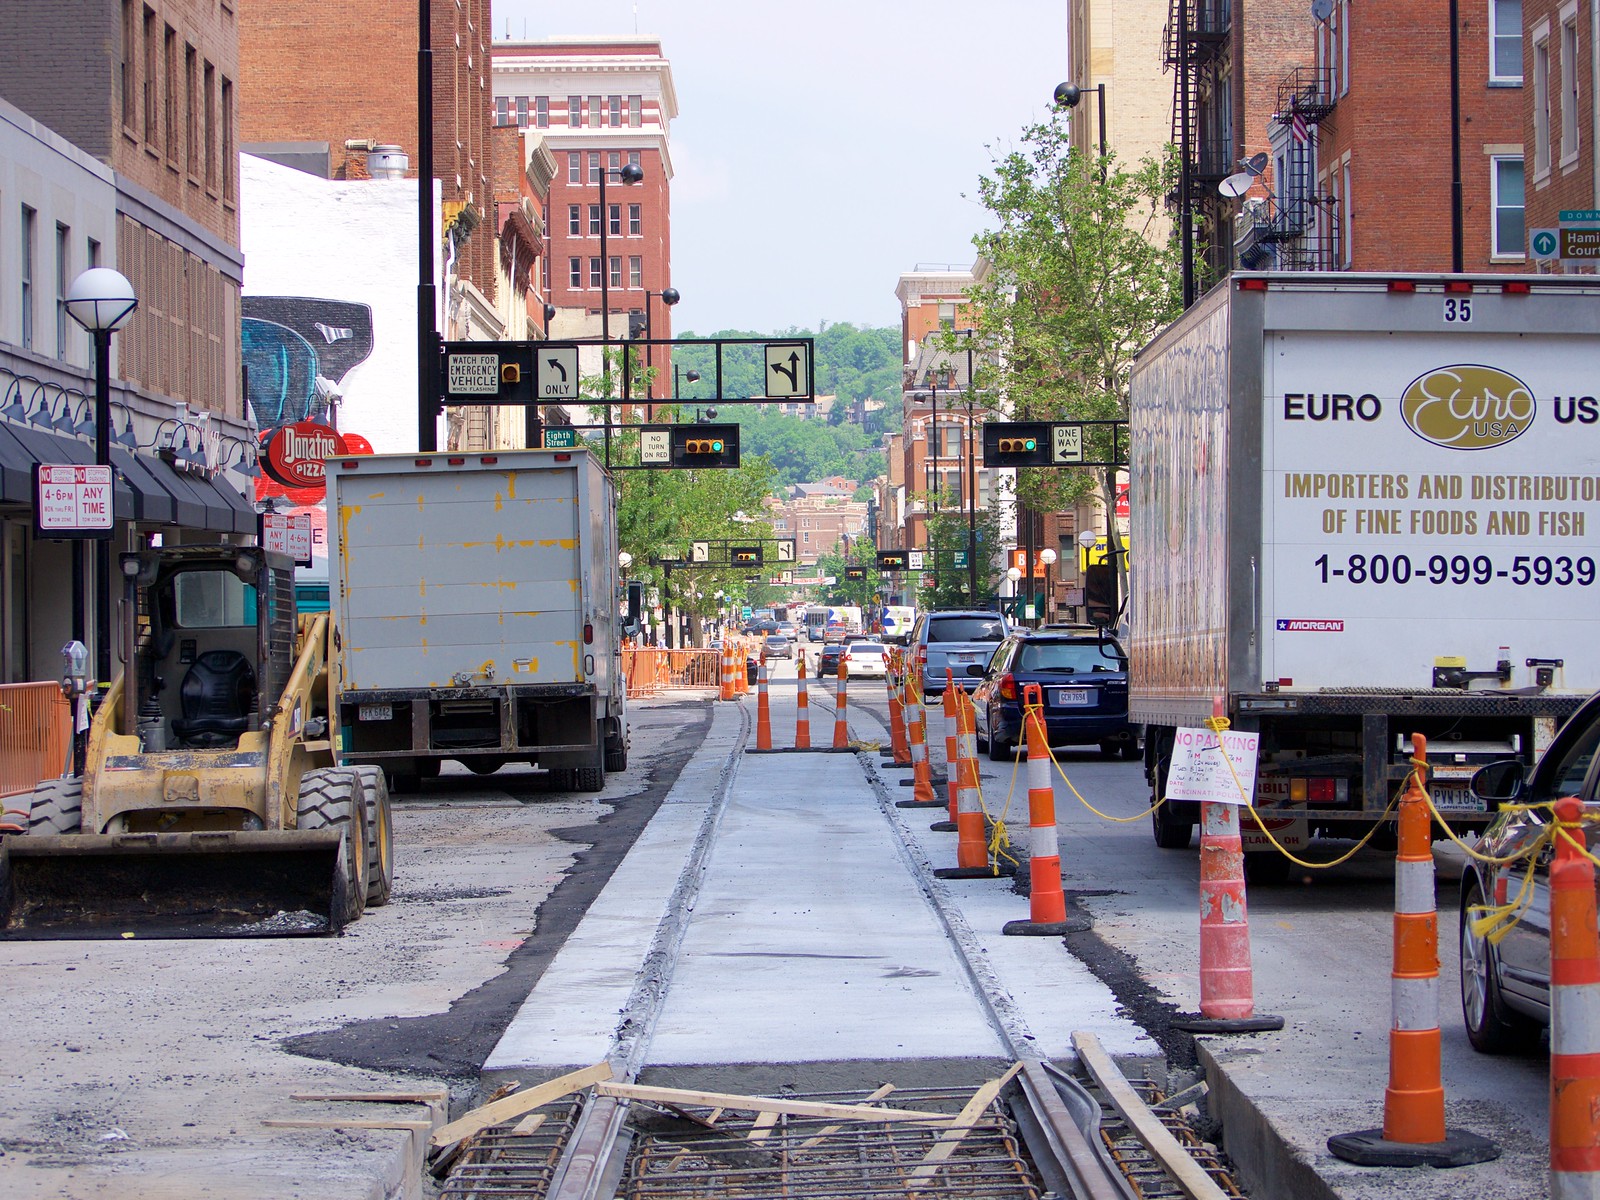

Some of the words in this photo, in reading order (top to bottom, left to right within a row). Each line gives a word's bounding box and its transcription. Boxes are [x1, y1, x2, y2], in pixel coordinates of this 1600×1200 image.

[1445, 298, 1471, 322] 35
[452, 356, 477, 364] WATCH
[480, 356, 496, 364] FOR
[450, 365, 498, 376] EMERGENCY
[450, 376, 497, 386] VEHICLE
[545, 385, 570, 395] ONLY
[1284, 393, 1381, 421] EURO
[1412, 370, 1535, 443] Euro
[1058, 429, 1077, 437] ONE
[1474, 422, 1520, 437] USA
[546, 431, 571, 440] Eighth
[284, 427, 336, 464] Donatos
[546, 439, 567, 447] Street
[1058, 439, 1078, 447] WAY
[41, 469, 51, 482] NO
[76, 469, 86, 482] NO
[296, 463, 326, 477] PIZZA
[1284, 473, 1409, 499] IMPORTERS
[1417, 475, 1463, 500] AND
[45, 489, 73, 500] 4-6PM
[83, 487, 104, 499] ANY
[82, 502, 105, 514] TIME
[1322, 509, 1347, 534] OF
[1355, 509, 1402, 535] FINE
[1410, 510, 1478, 536] FOODS
[1486, 511, 1530, 536] AND
[1538, 511, 1585, 537] FISH
[269, 531, 283, 539] ANY
[268, 541, 284, 551] TIME
[1314, 554, 1596, 585] 1-800-999-5939
[1290, 621, 1341, 630] MORGAN
[1176, 732, 1193, 746] NO
[1195, 734, 1257, 752] PARKING
[1173, 788, 1214, 796] CINCINNATI
[1284, 836, 1299, 845] OH
